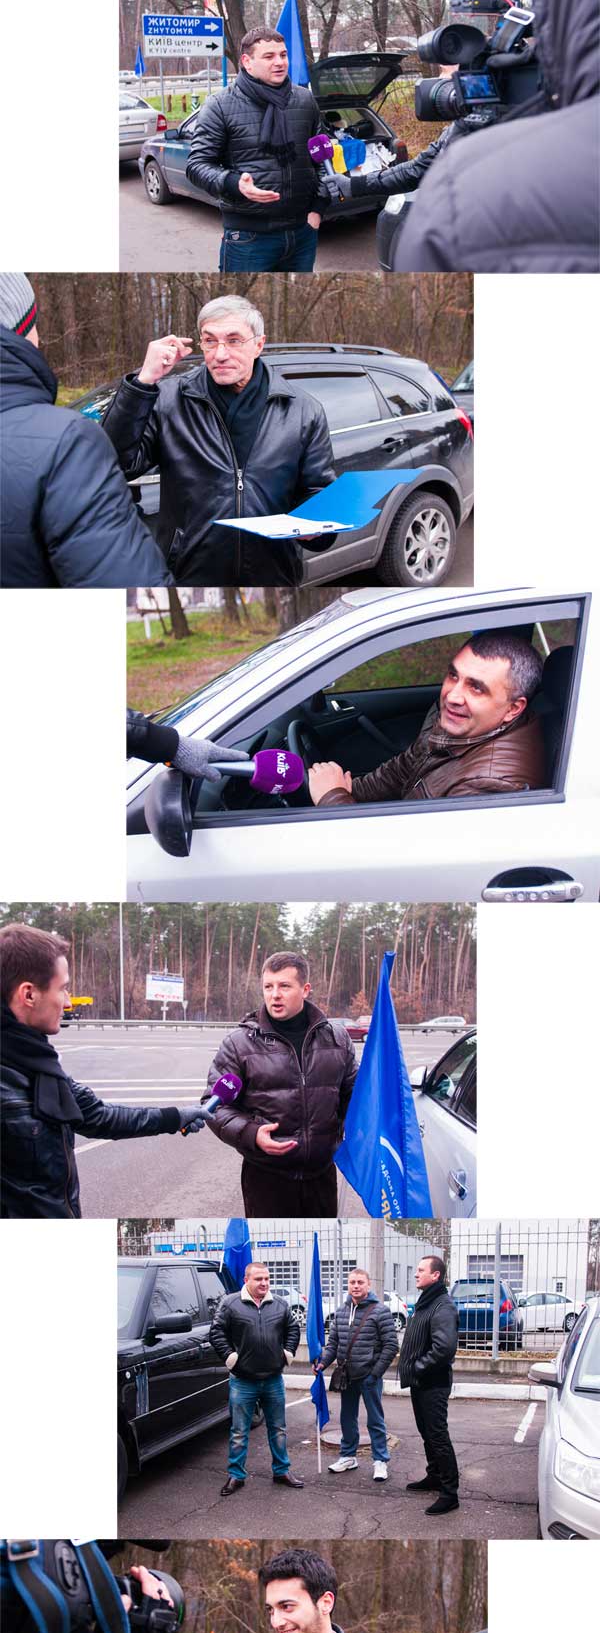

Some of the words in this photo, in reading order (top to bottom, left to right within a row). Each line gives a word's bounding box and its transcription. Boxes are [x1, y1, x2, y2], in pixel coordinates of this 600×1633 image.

[148, 17, 201, 27] ЖИТОМИР
[148, 27, 193, 35] ZHYTOMYR
[148, 37, 173, 46] КИЇВ
[174, 40, 203, 48] центр
